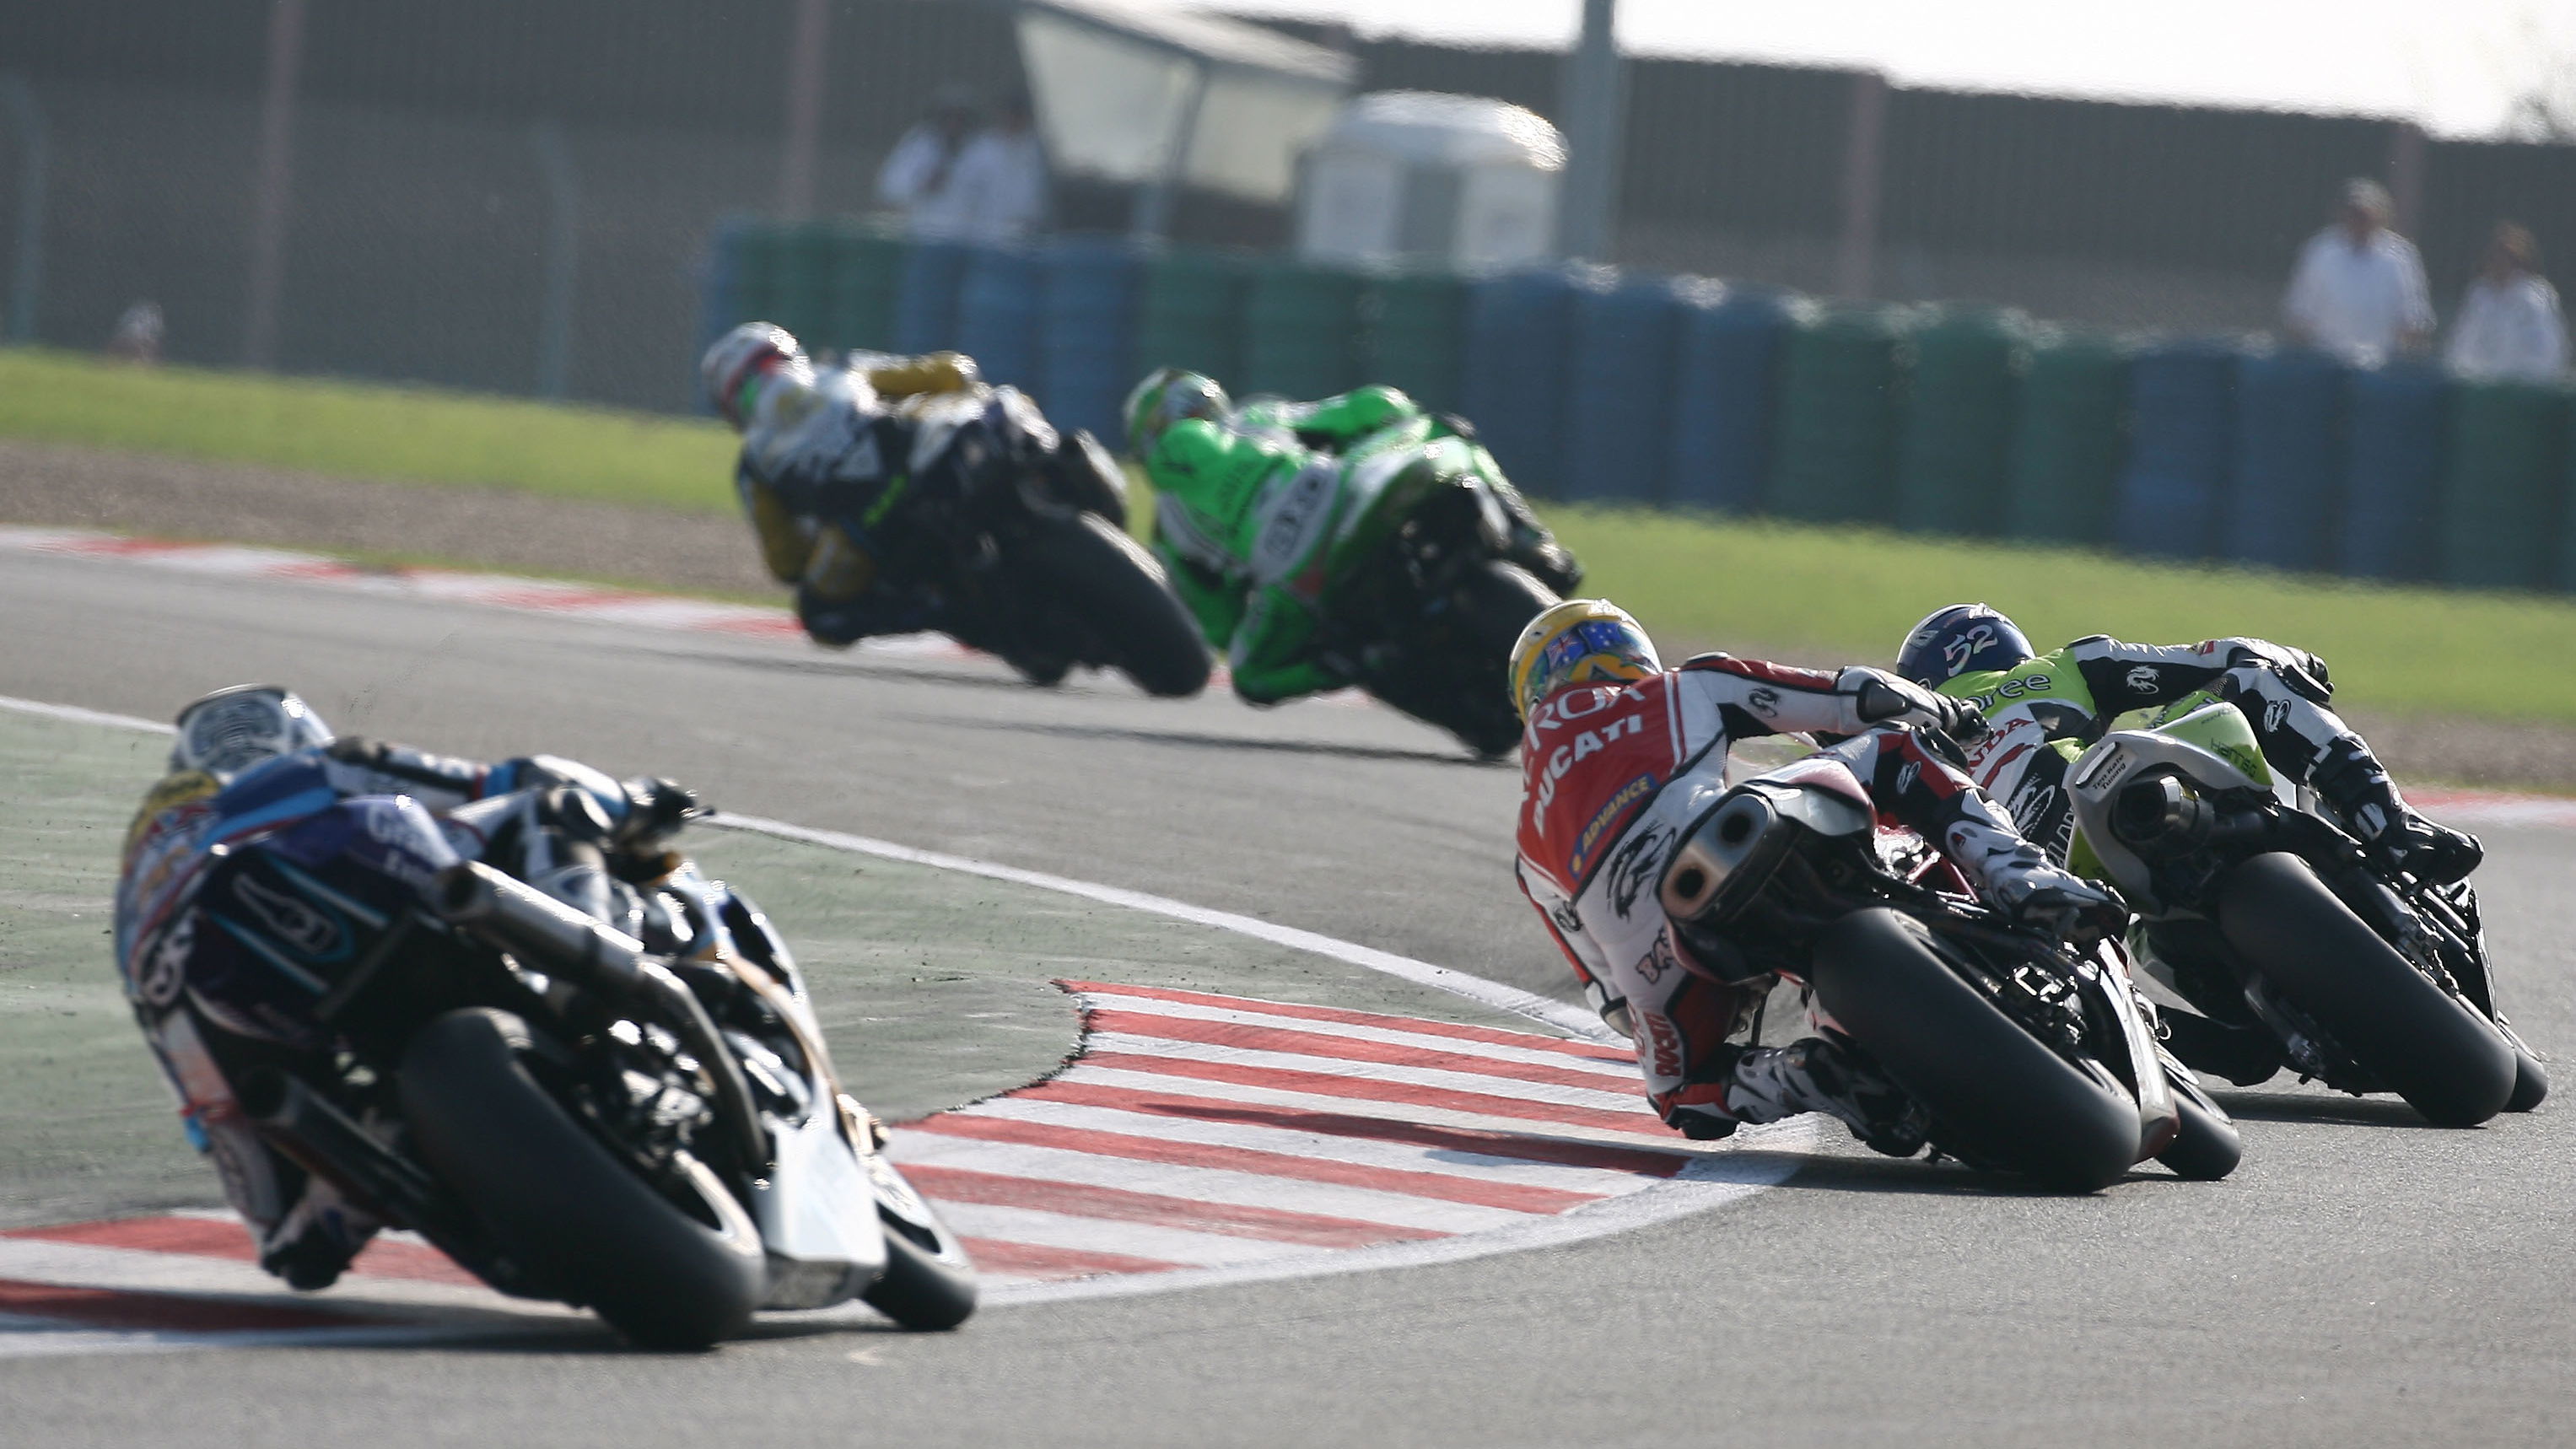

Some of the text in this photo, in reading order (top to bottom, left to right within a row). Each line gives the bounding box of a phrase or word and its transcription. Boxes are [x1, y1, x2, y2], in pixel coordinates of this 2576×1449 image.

[1943, 624, 1998, 677] 52
[1533, 714, 1643, 839] DUCATI
[2100, 762, 2126, 790] Tuning
[1582, 776, 1649, 853] ADVANCE
